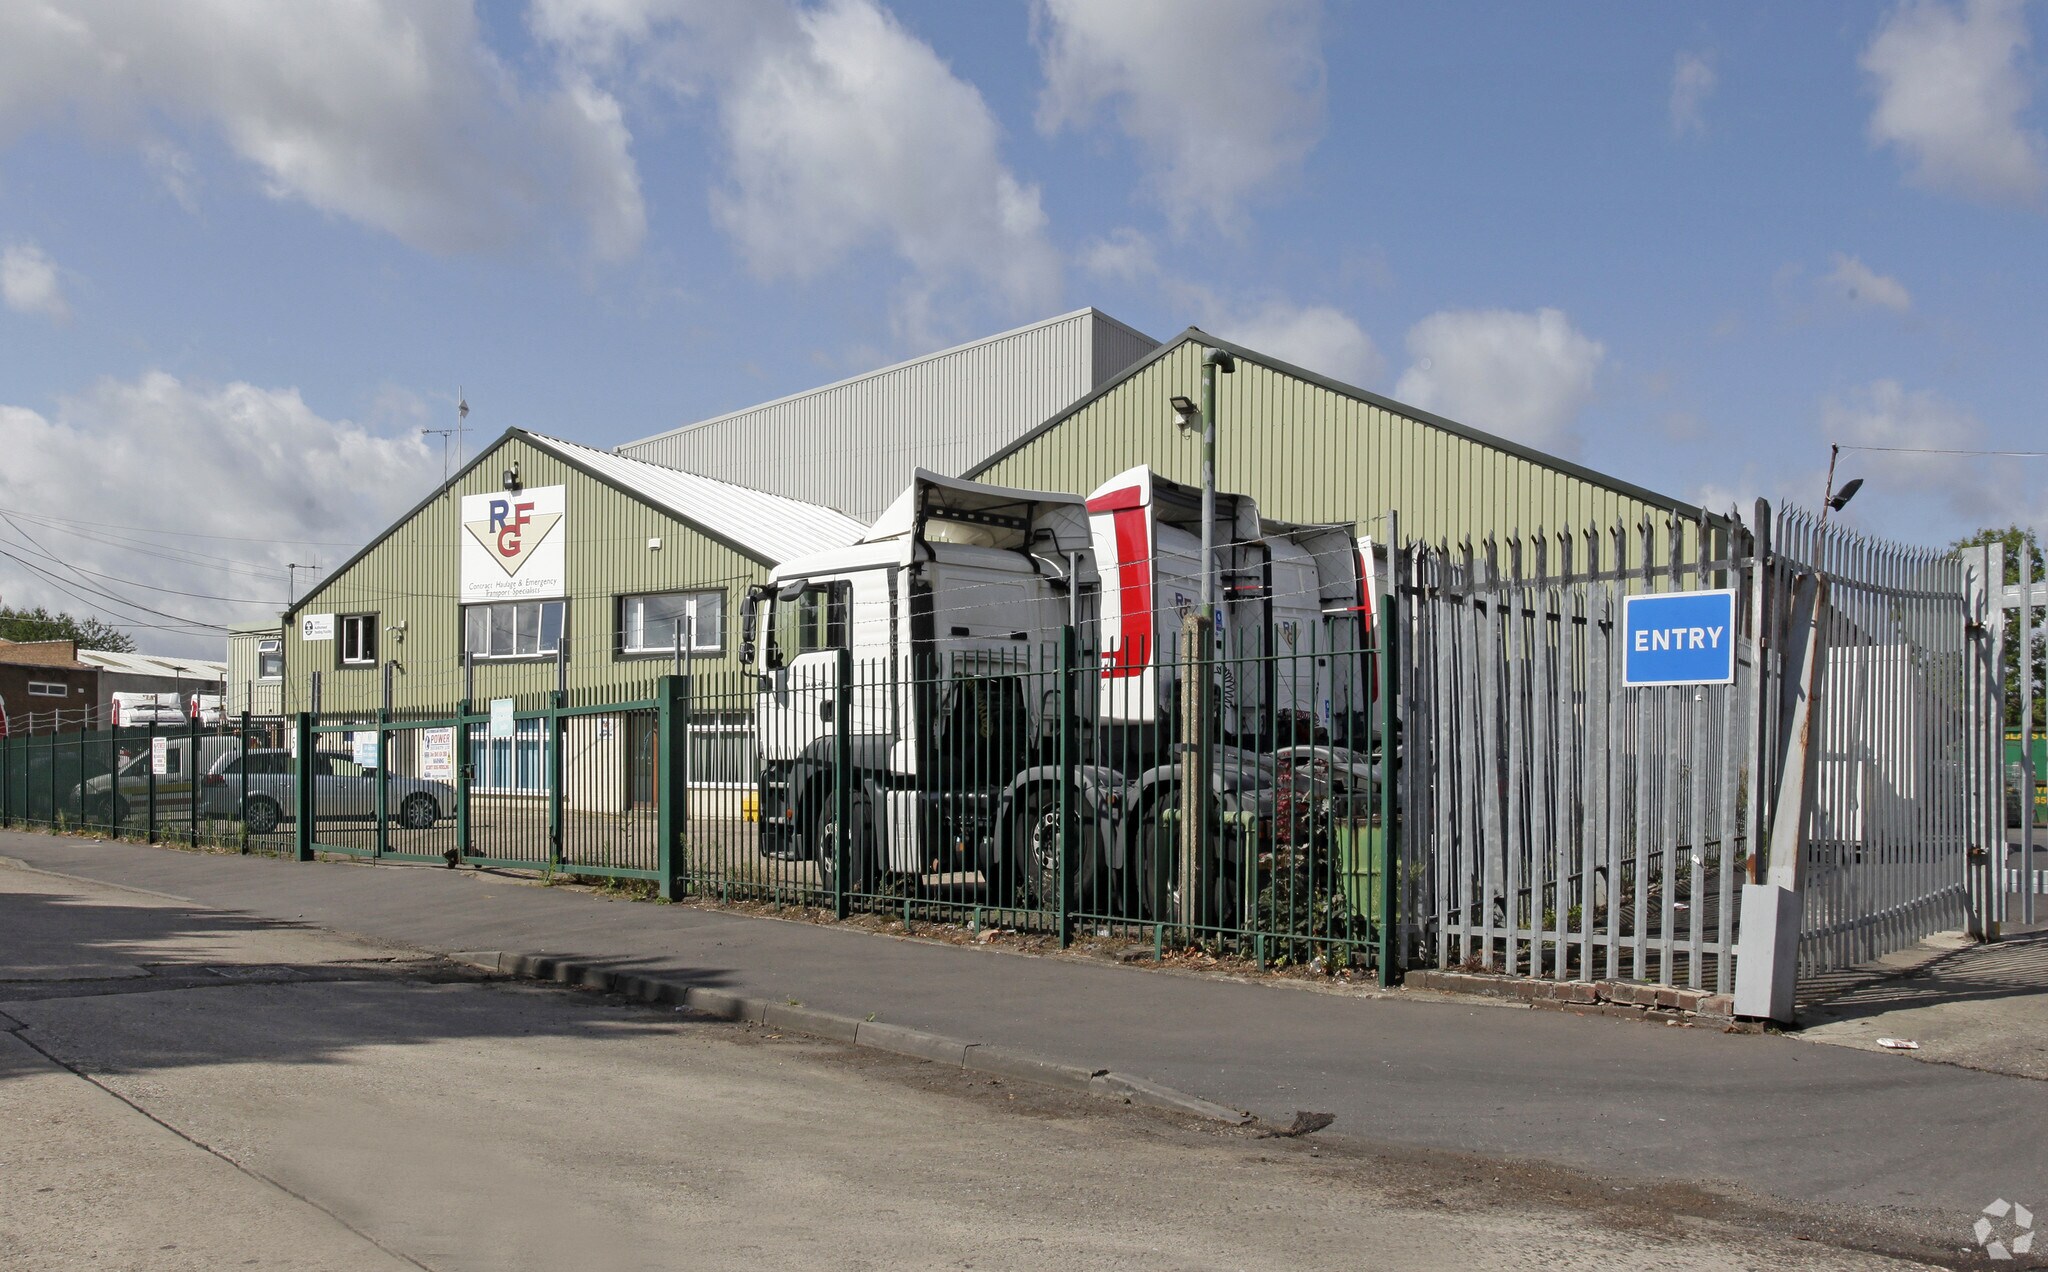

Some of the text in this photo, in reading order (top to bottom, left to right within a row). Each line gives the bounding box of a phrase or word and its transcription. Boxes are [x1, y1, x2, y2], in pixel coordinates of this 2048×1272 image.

[469, 582, 493, 590] Contract
[496, 581, 516, 589] Haulage
[526, 578, 557, 587] Emergency
[485, 587, 541, 598] Transport Specialists
[1635, 626, 1724, 652] ENTRY
[431, 734, 450, 743] POWER
